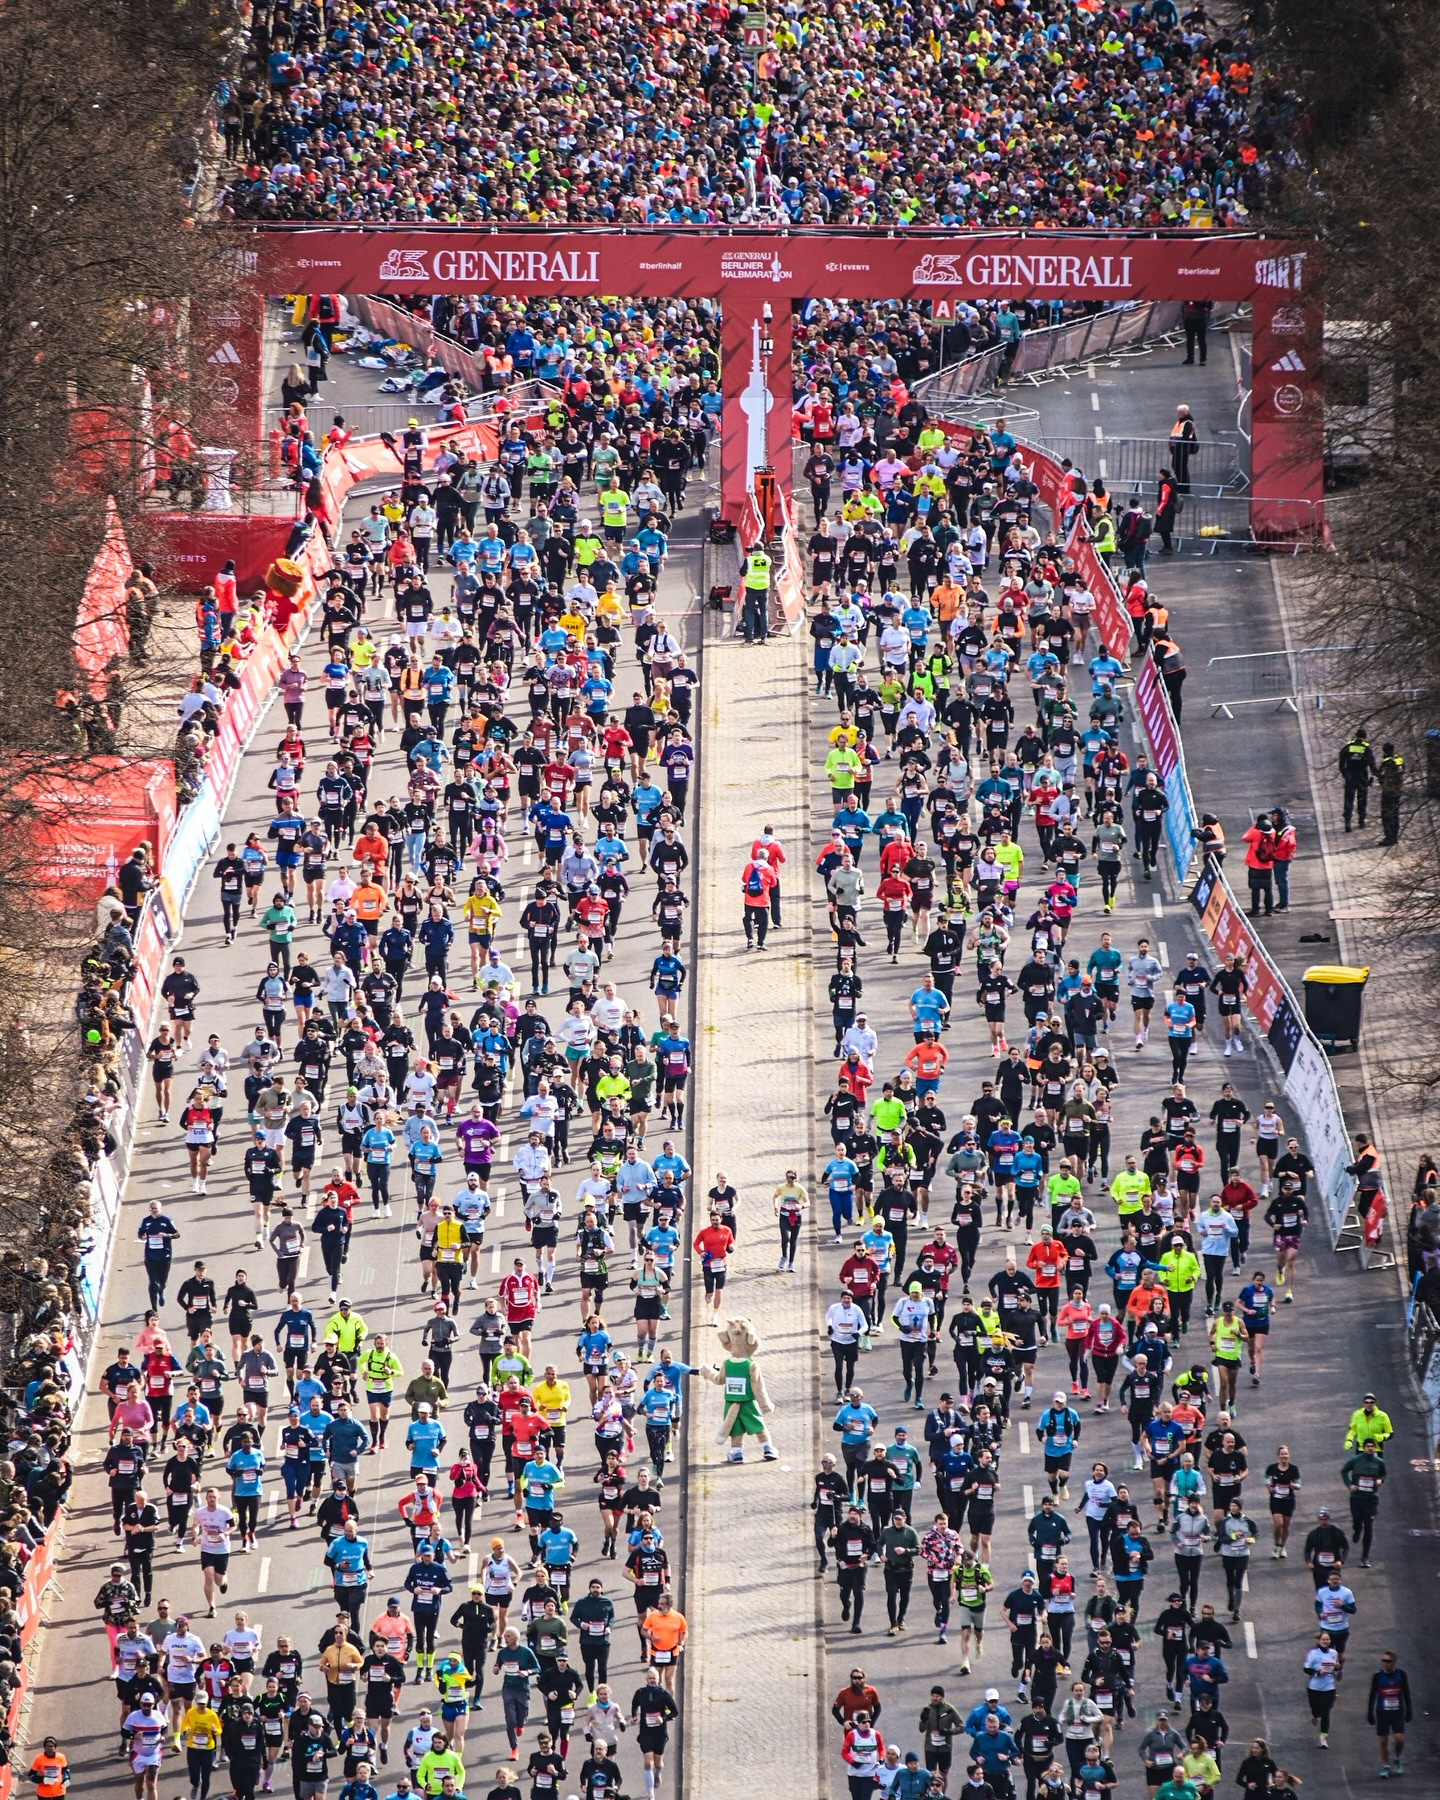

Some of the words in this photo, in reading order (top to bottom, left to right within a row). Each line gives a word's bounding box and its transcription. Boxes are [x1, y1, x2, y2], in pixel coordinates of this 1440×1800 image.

[748, 30, 761, 45] A
[733, 252, 771, 260] GENERALI
[433, 250, 600, 282] GENERALI
[639, 262, 682, 270] #berlinhalf
[721, 261, 763, 270] BERLINER
[965, 255, 1133, 287] GENERALI
[1177, 267, 1220, 275] #berlinhalf
[1255, 252, 1307, 290] START
[935, 300, 951, 317] A
[167, 555, 207, 563] EVENTS
